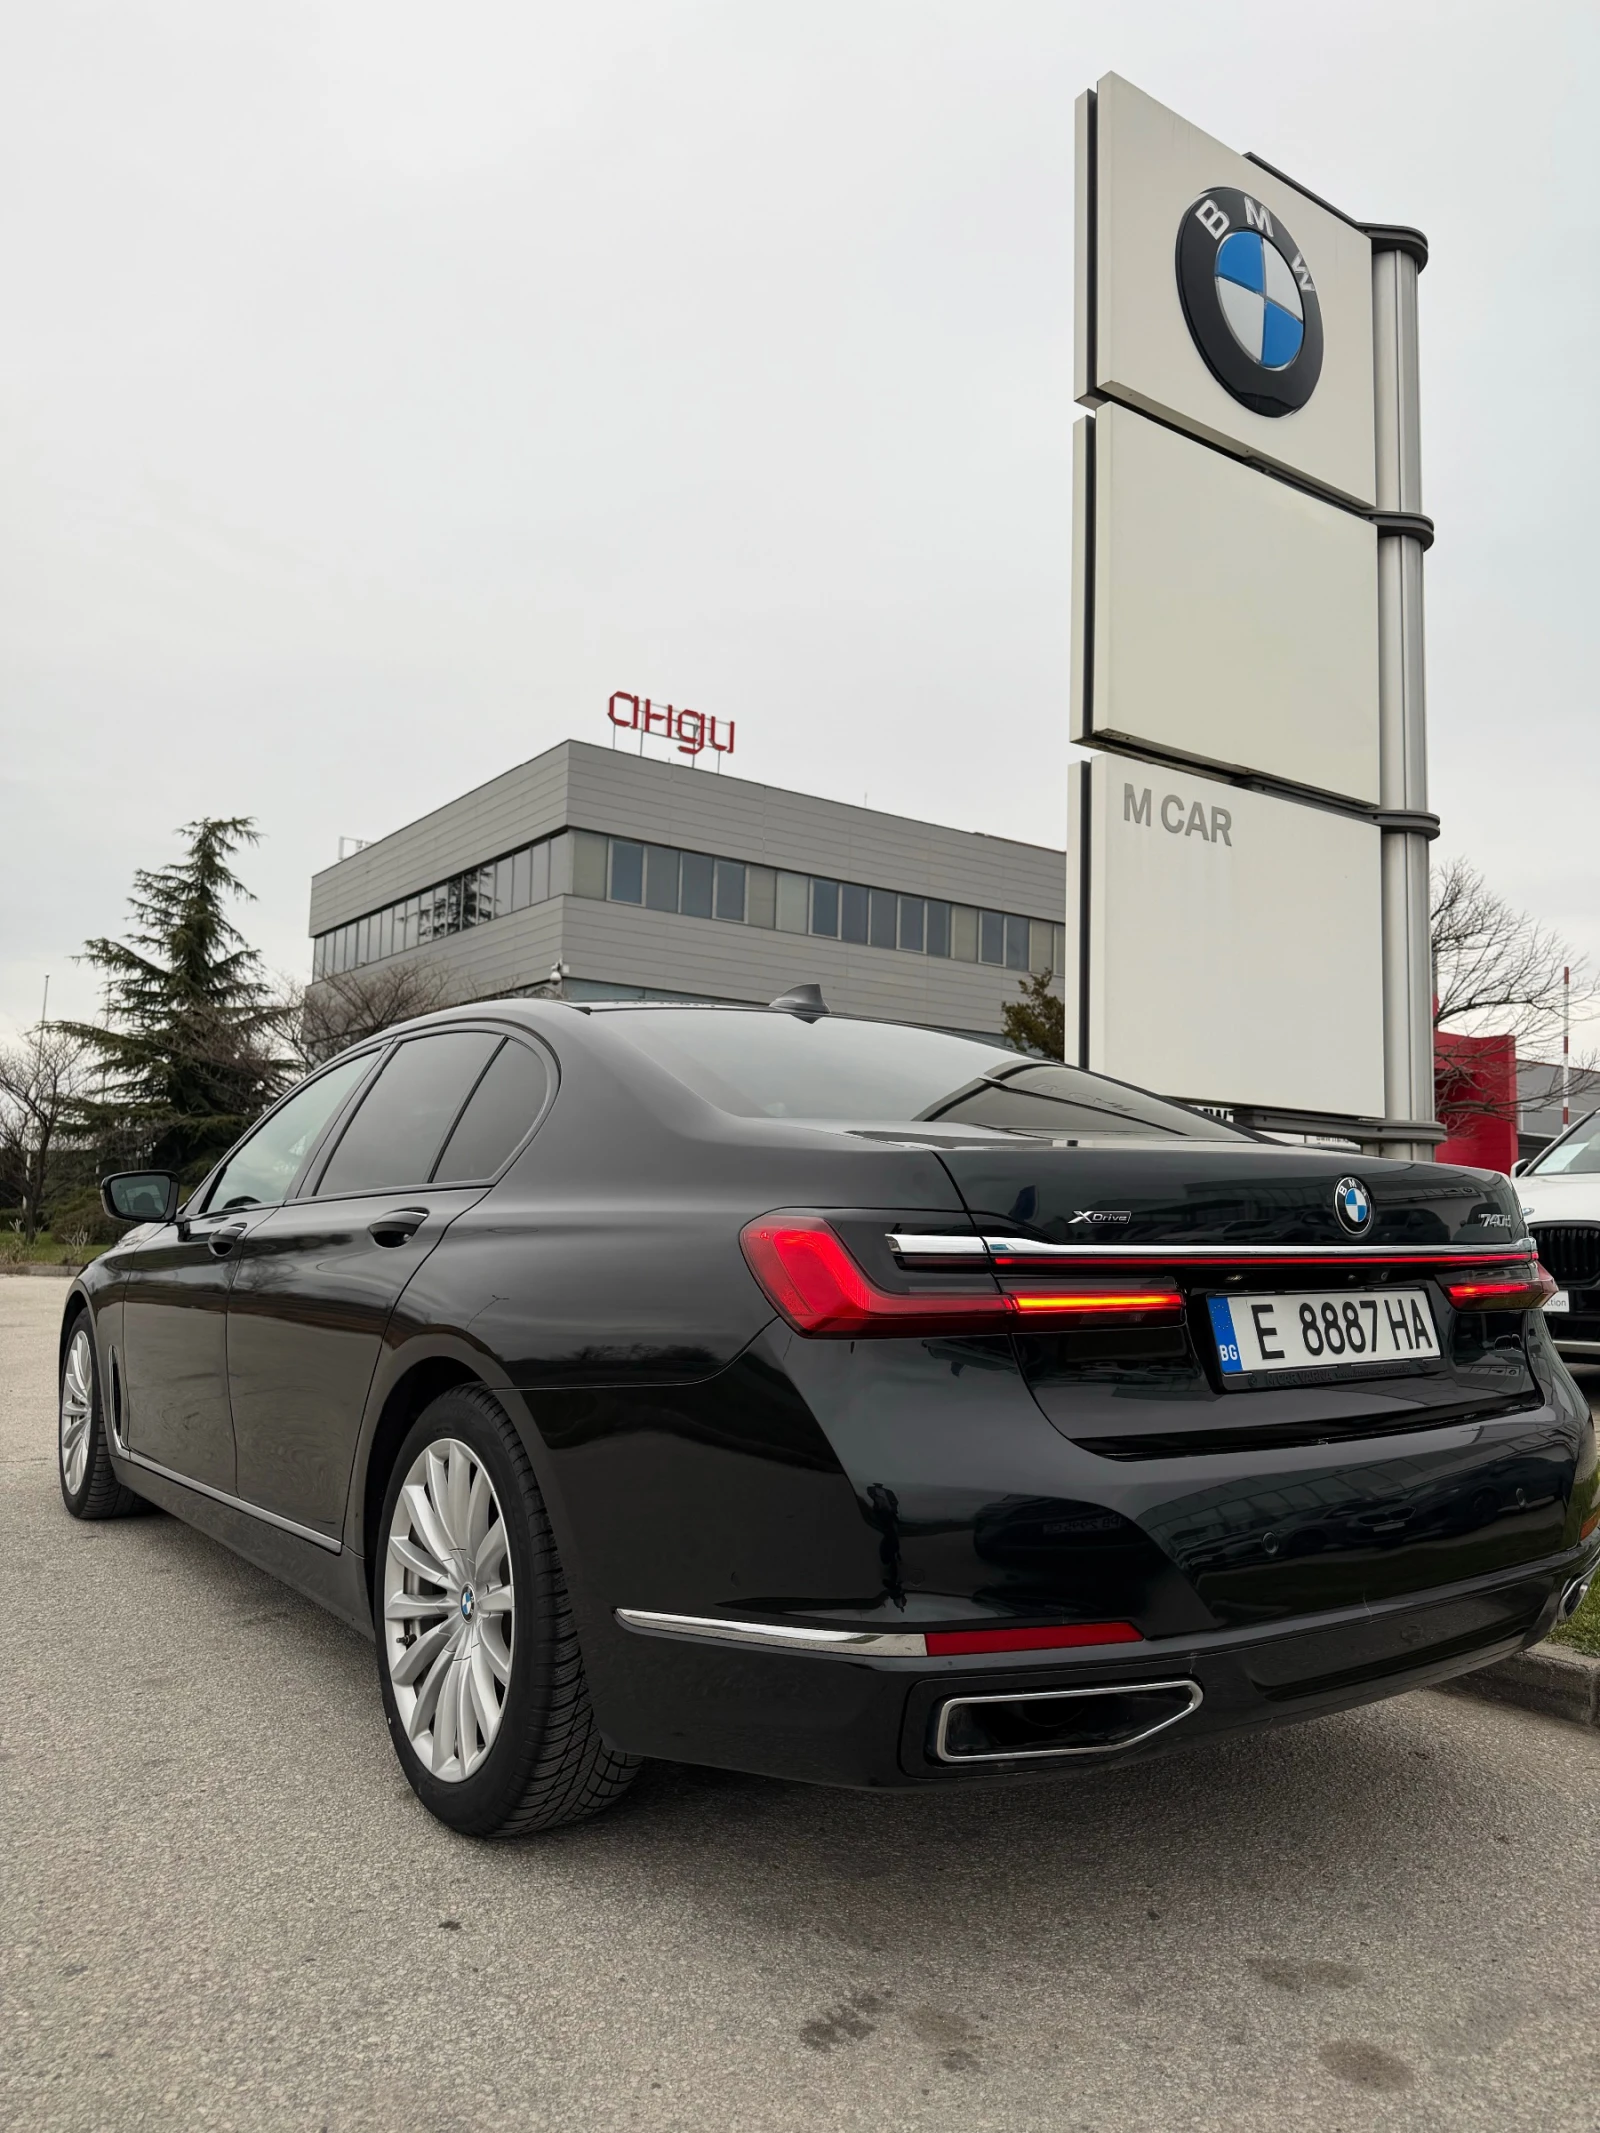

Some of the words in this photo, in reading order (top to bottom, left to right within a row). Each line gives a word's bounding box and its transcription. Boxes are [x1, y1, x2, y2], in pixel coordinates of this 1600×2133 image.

[1195, 196, 1315, 292] BMW
[1124, 783, 1152, 827] M
[1161, 795, 1232, 847] CAR
[1338, 1179, 1367, 1197] BMW
[1220, 1344, 1239, 1361] BG
[1251, 1304, 1285, 1360] E
[1299, 1300, 1378, 1356] 8887
[1384, 1299, 1433, 1351] HA
